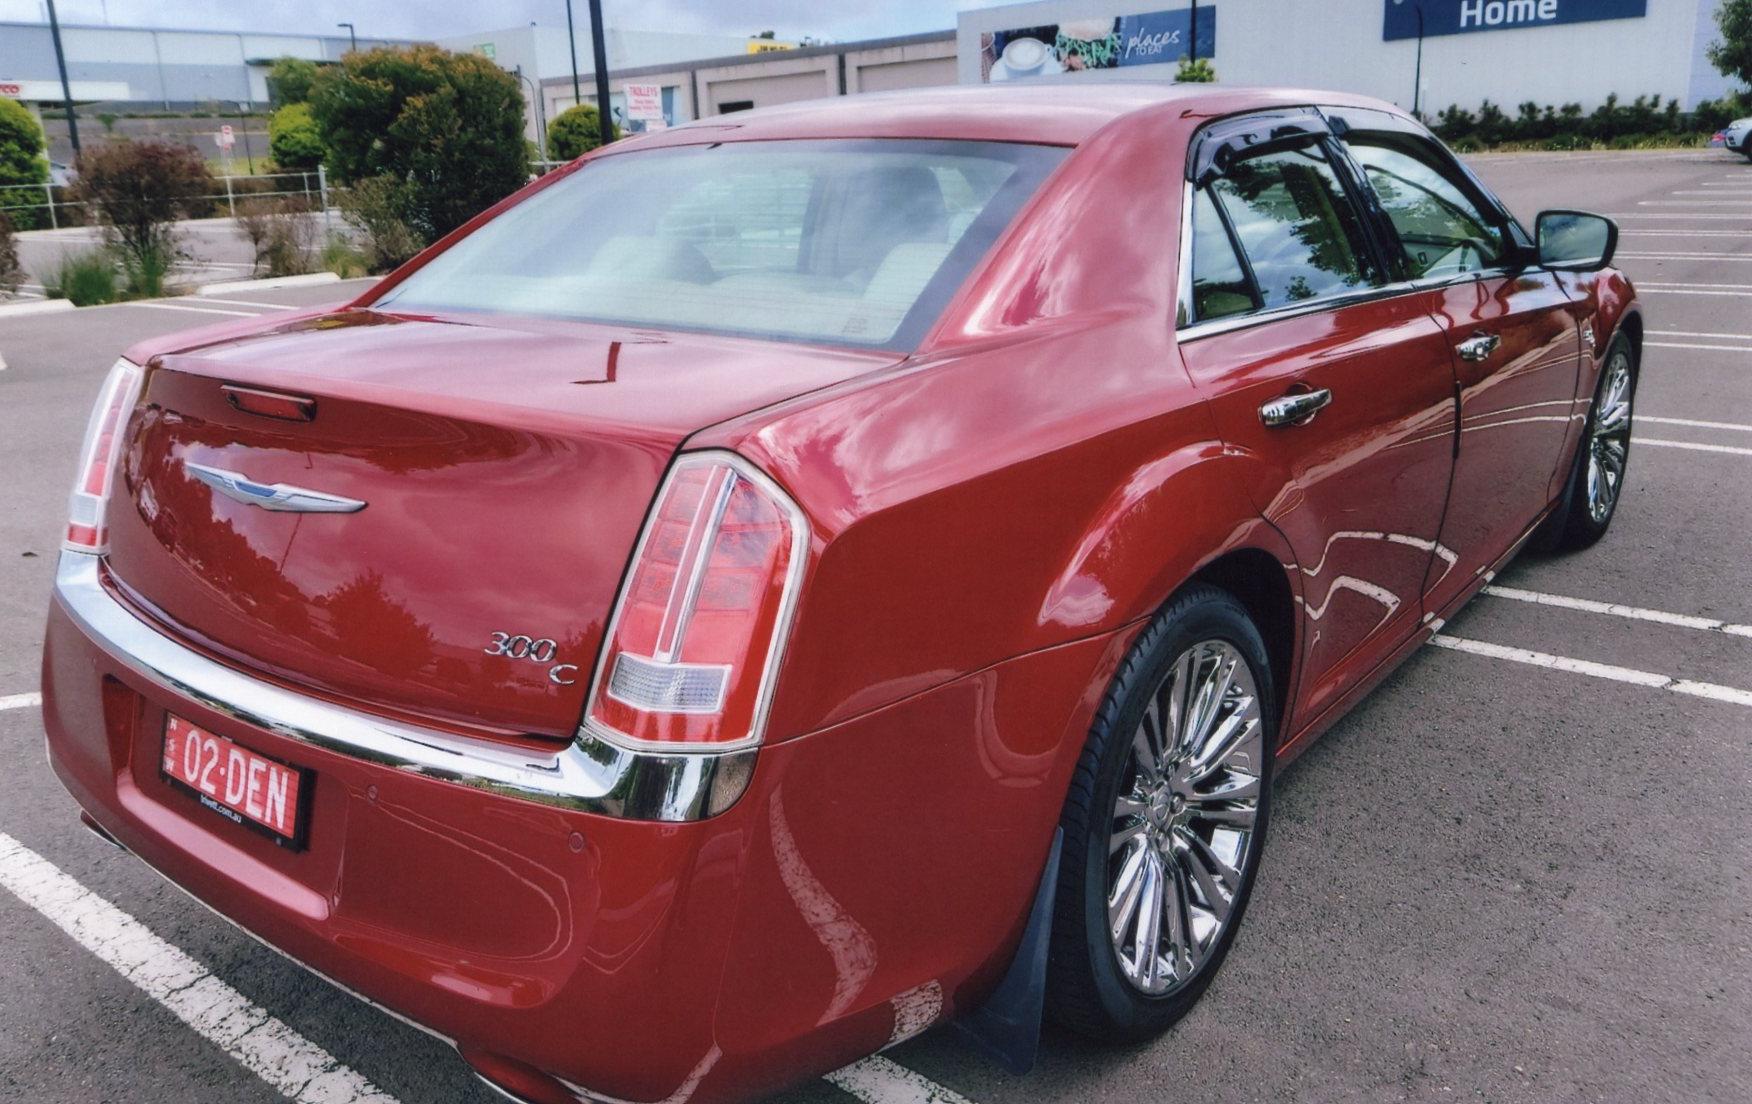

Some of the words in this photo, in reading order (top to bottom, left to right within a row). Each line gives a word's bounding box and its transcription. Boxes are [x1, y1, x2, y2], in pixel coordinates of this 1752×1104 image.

[1460, 0, 1557, 27] Home
[1125, 27, 1180, 59] places
[1135, 46, 1146, 56] TO
[1148, 44, 1162, 55] EAT
[484, 631, 557, 662] 300
[549, 664, 578, 685] C
